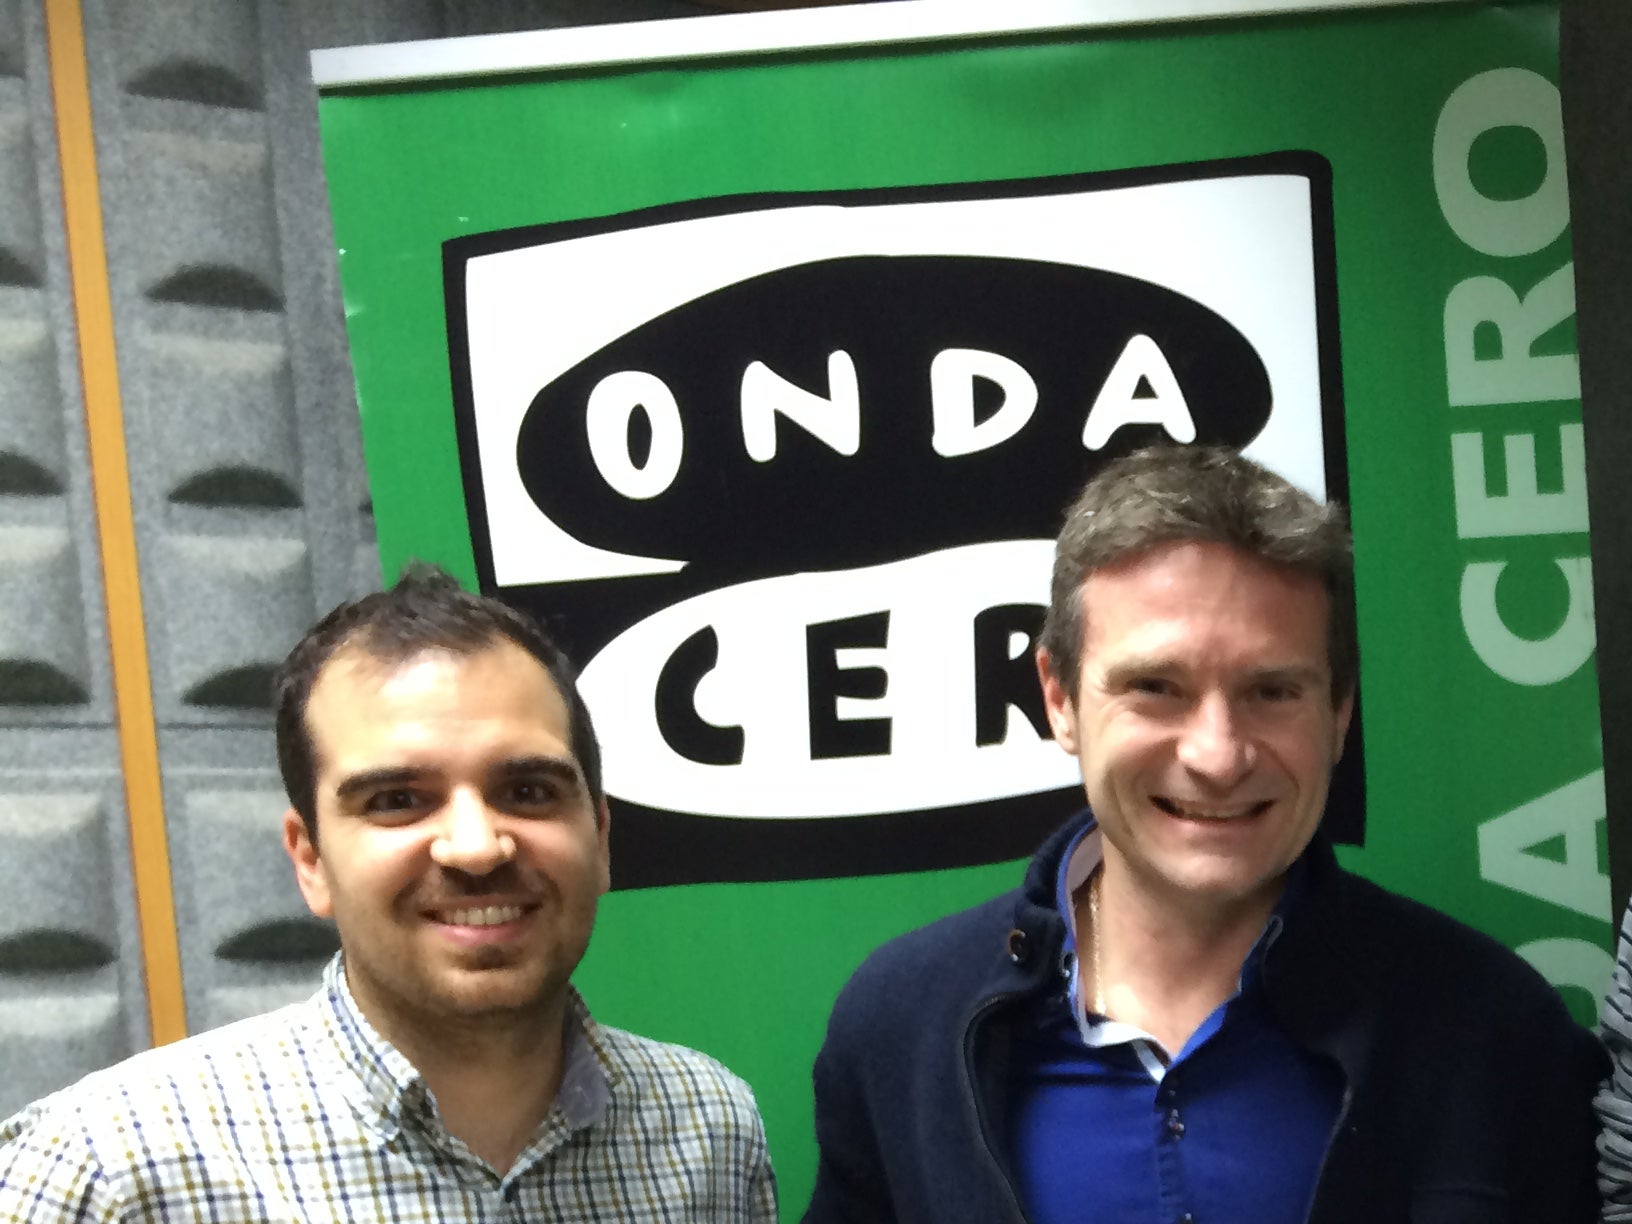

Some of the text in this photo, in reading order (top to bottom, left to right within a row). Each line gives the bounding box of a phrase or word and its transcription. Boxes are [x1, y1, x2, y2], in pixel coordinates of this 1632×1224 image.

[585, 332, 1197, 500] ONDA
[1432, 66, 1598, 686] CERO
[655, 603, 1056, 766] CER
